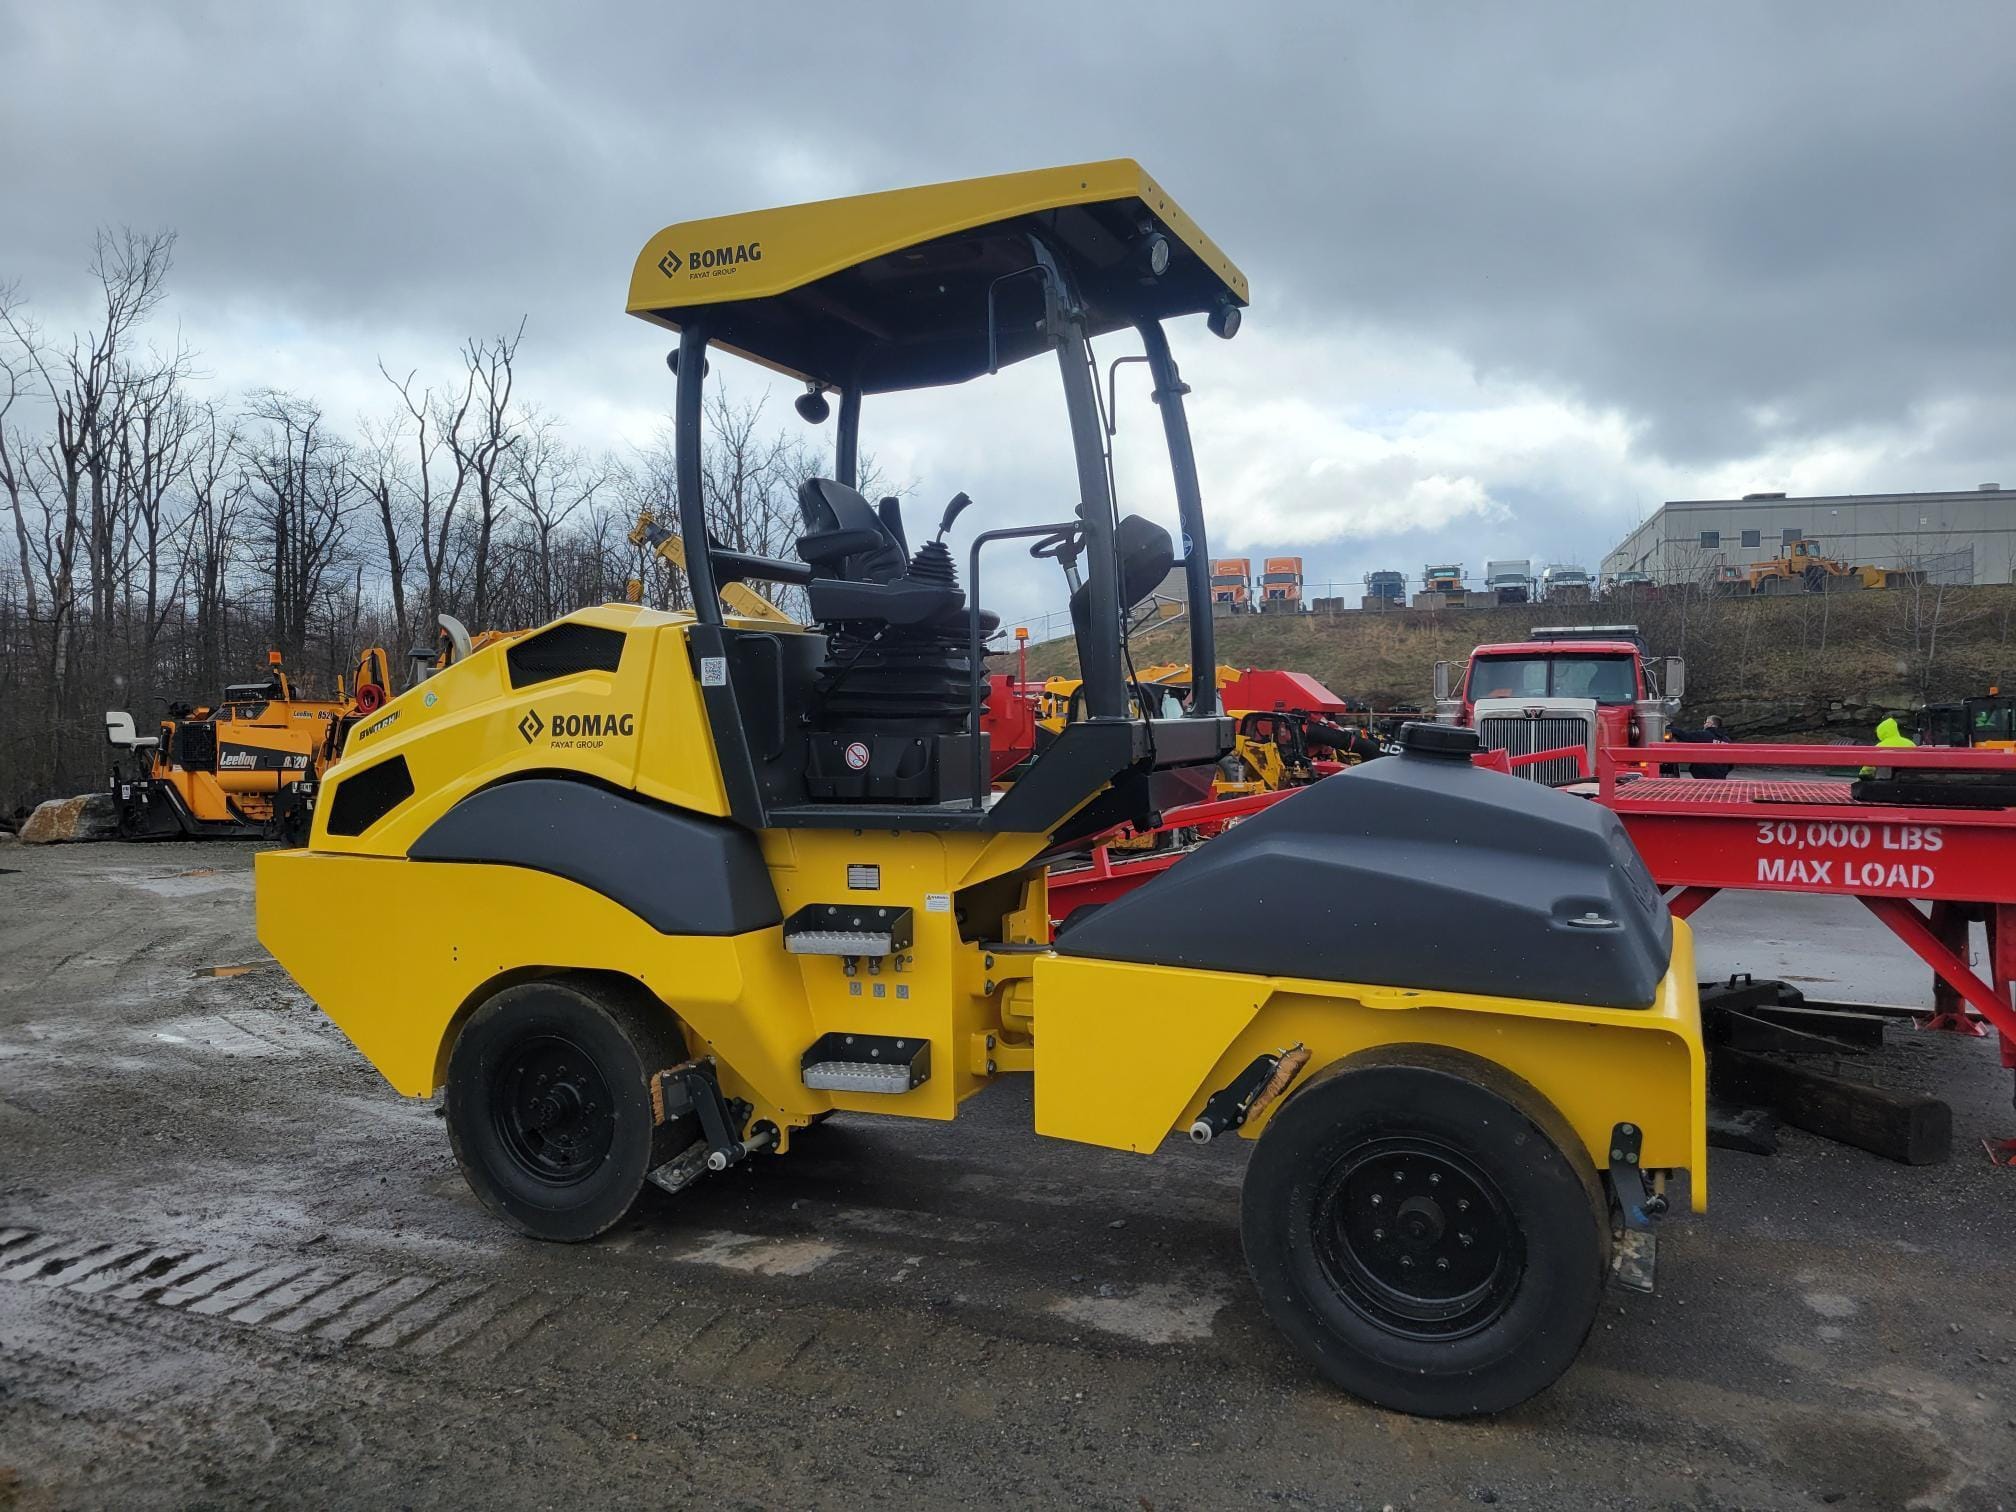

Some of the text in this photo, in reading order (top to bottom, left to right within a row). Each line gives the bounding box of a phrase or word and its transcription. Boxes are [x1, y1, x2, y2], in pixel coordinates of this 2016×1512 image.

[689, 242, 762, 271] BOMAG
[689, 267, 737, 280] FAYAT GROUP
[551, 713, 634, 737] BOMAG
[550, 740, 604, 749] FAYAT GROUP
[220, 751, 258, 770] LeeBoy
[1756, 821, 1943, 852] 30,000 LBS
[1757, 858, 1935, 889] MAX LOAD
